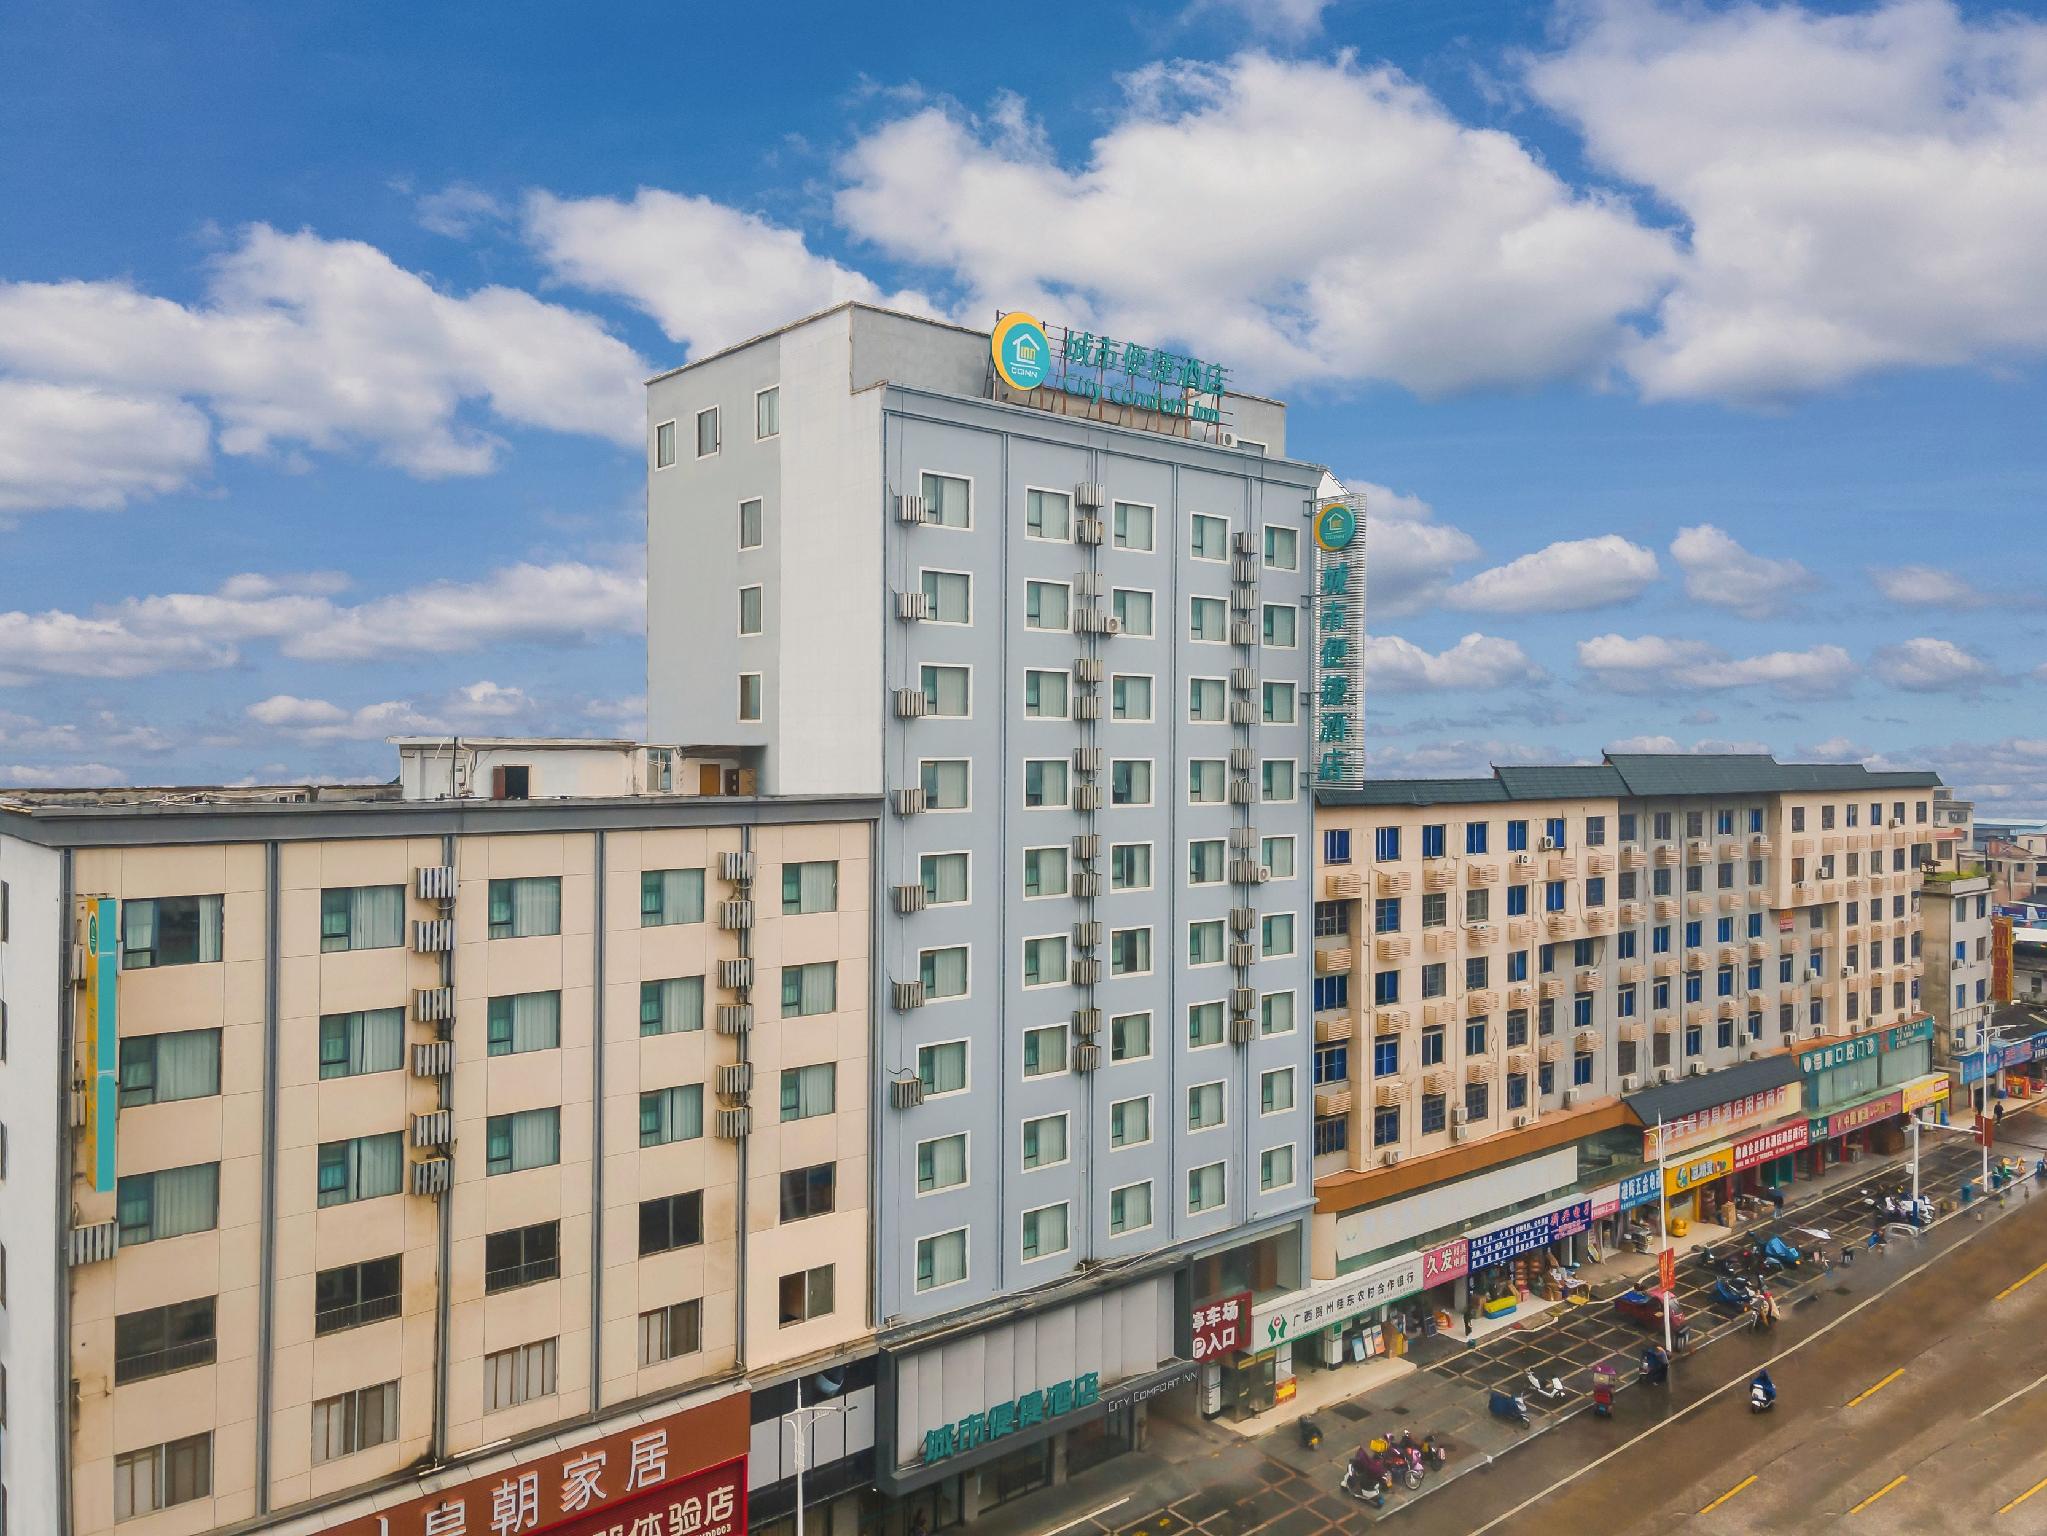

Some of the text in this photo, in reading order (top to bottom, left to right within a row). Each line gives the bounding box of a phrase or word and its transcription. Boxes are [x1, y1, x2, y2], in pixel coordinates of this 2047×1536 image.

[924, 1371, 1099, 1465] 城市便捷酒店
[376, 1428, 669, 1536] 皇朝家居
